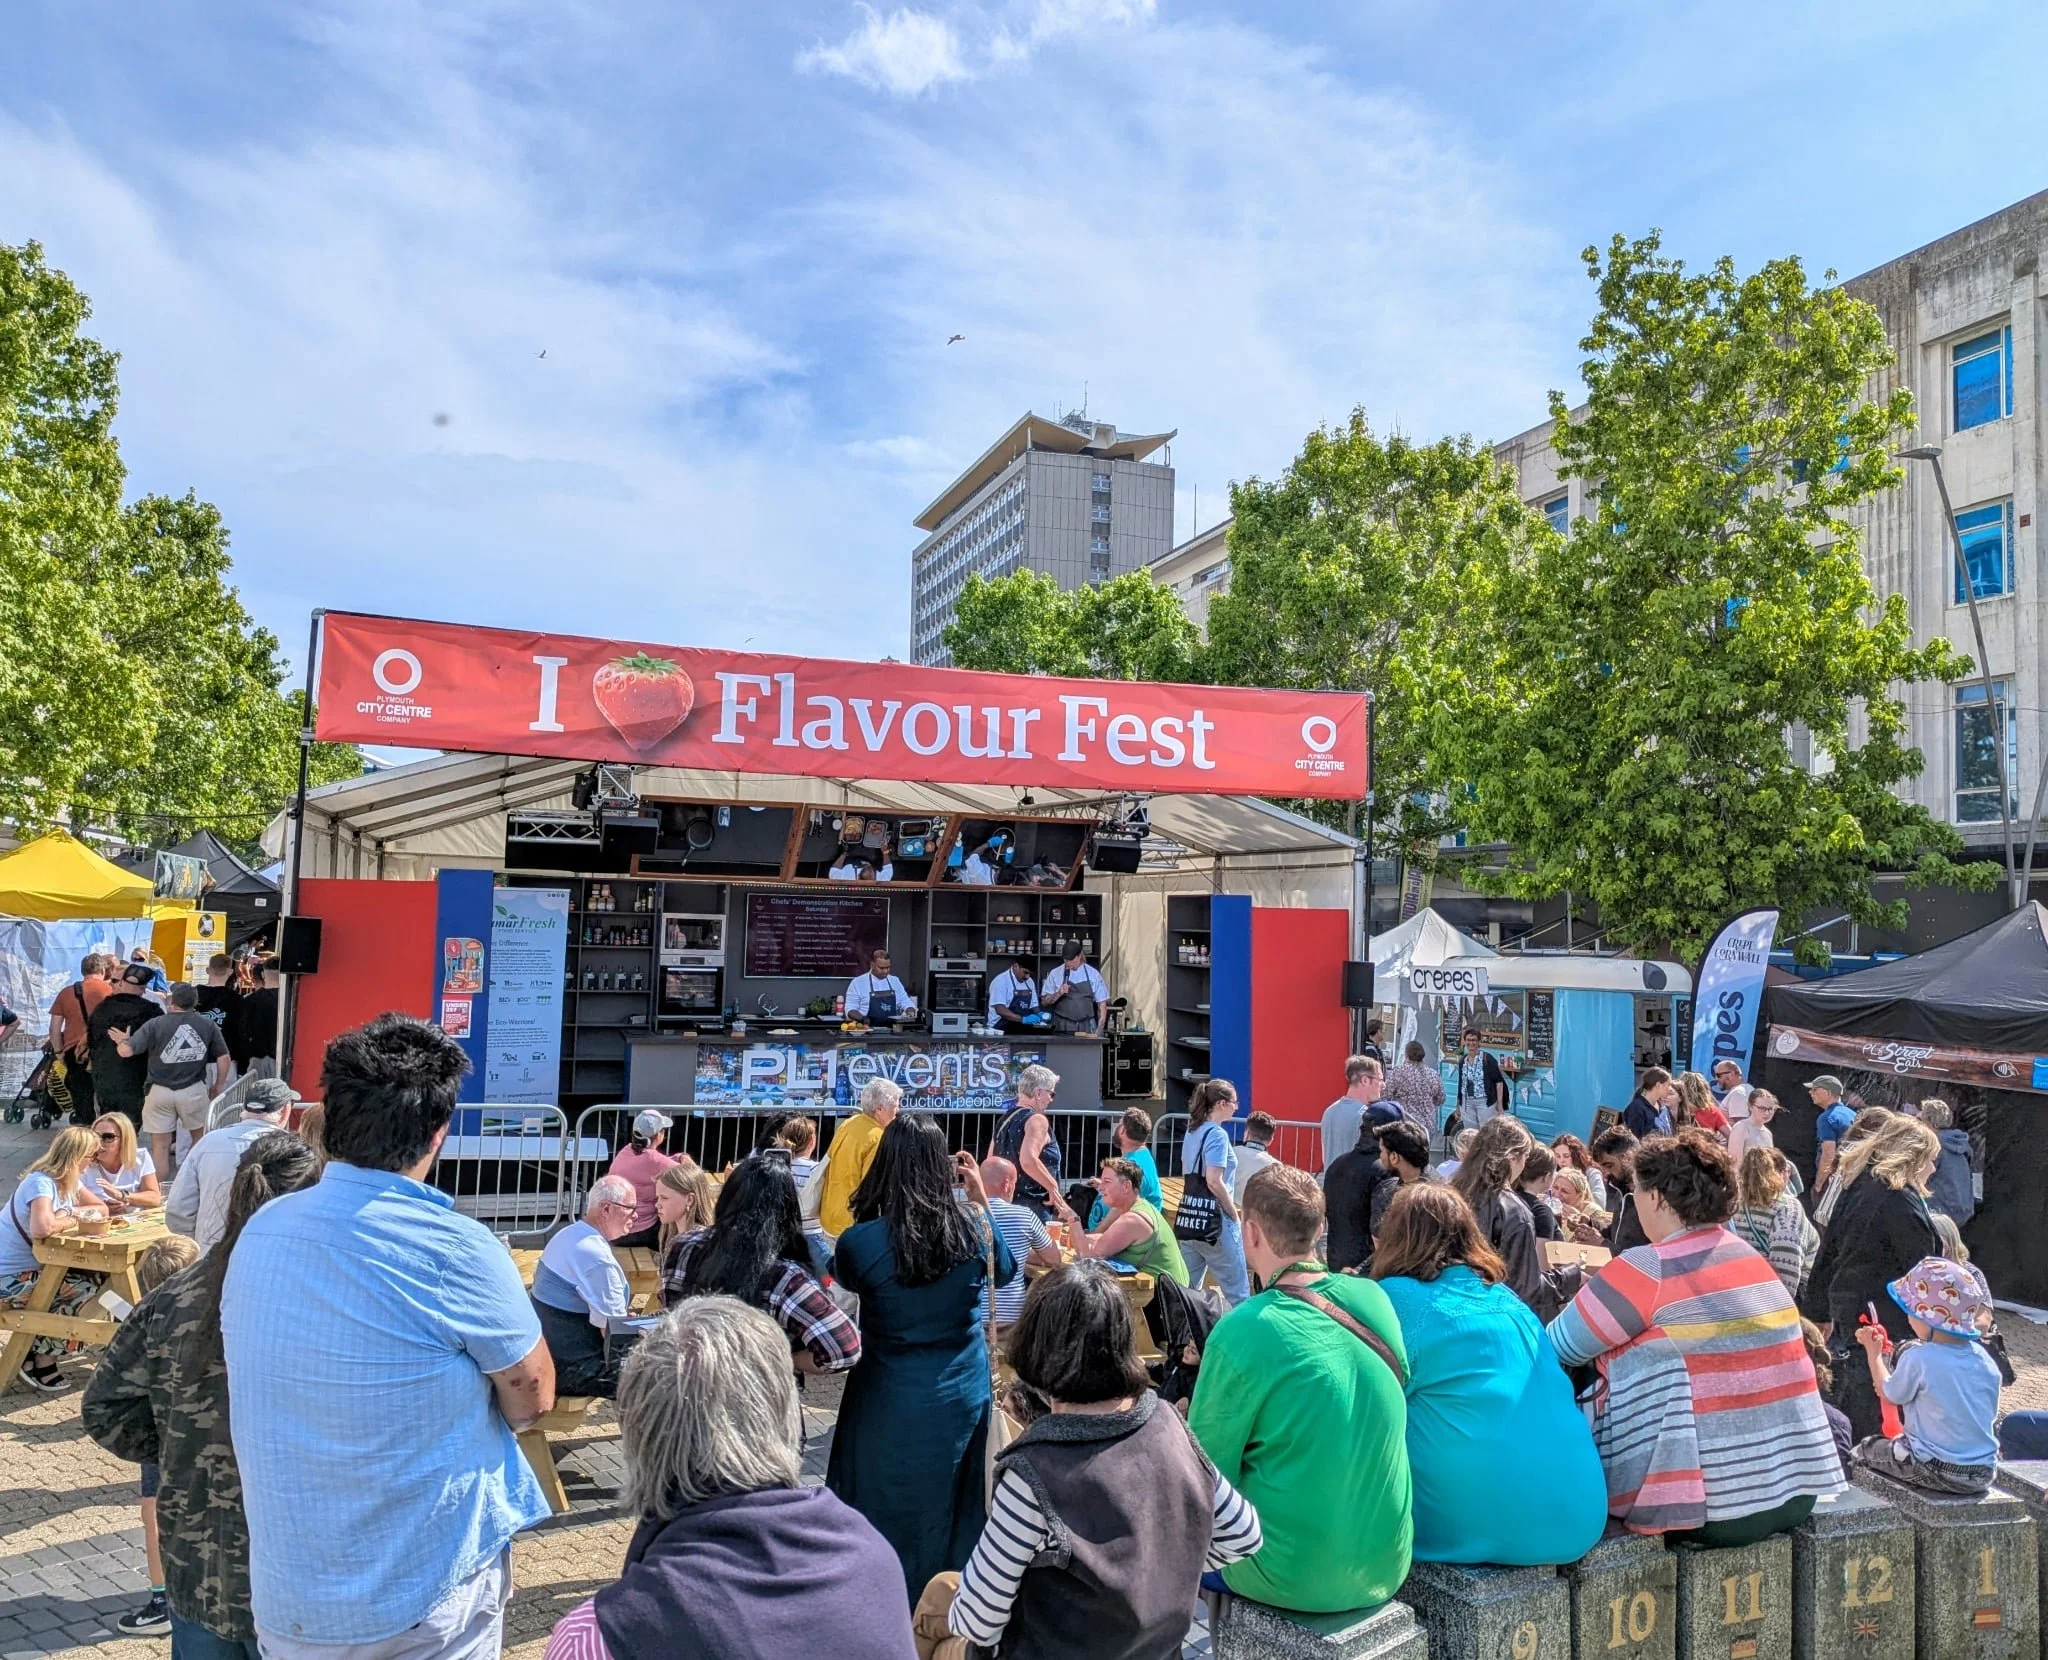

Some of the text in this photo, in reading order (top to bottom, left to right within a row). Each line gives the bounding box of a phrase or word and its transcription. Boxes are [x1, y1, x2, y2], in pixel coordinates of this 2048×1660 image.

[376, 695, 415, 705] PLYMOUTH
[356, 701, 432, 718] CITY CENTRE
[529, 655, 1216, 770] I Flavour Fest
[376, 715, 411, 724] COMPANY
[1294, 759, 1345, 771] CITY CENTRE
[1727, 937, 1753, 951] CREPE
[1714, 948, 1761, 964] CORNWALL
[1413, 969, 1474, 992] crepes
[1879, 1042, 1935, 1060] Street
[742, 1046, 1006, 1090] PL1 events
[1894, 1057, 1922, 1074] Eats
[956, 1094, 1003, 1109] people
[1176, 1215, 1208, 1231] MARKET
[1975, 1546, 1997, 1597] 1
[1841, 1555, 1893, 1607] 12
[1720, 1571, 1766, 1625] 11
[1608, 1591, 1657, 1649] 10
[1511, 1620, 1538, 1660] 9
